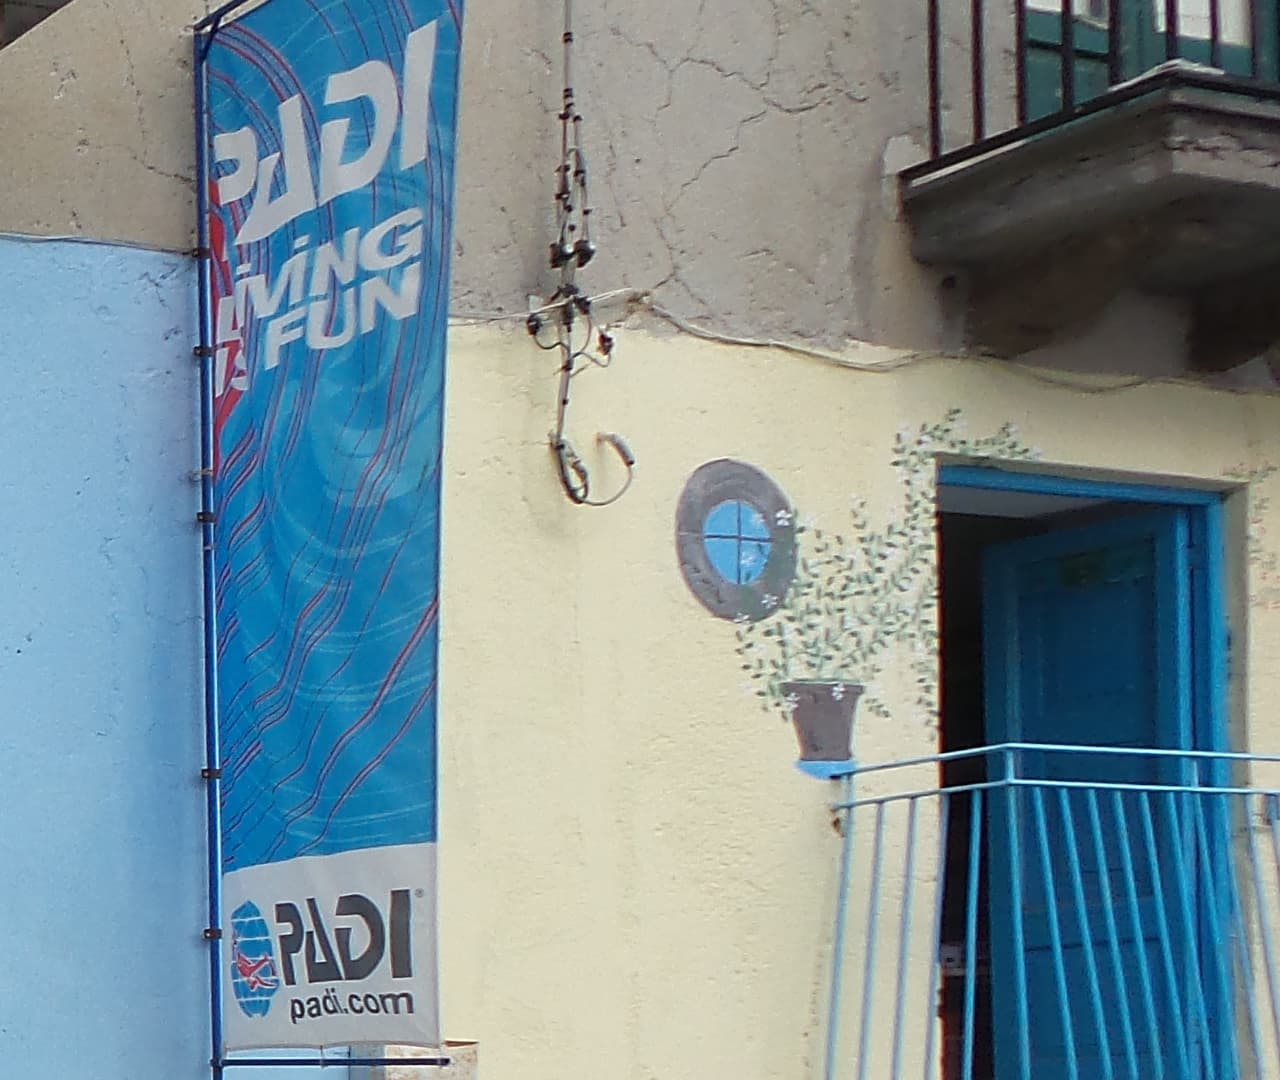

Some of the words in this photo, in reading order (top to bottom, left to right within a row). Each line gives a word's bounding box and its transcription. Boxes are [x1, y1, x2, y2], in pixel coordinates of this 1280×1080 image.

[213, 19, 438, 246] PADI
[265, 262, 422, 371] FUN
[275, 889, 412, 986] PADI
[290, 988, 414, 1024] padi.com
